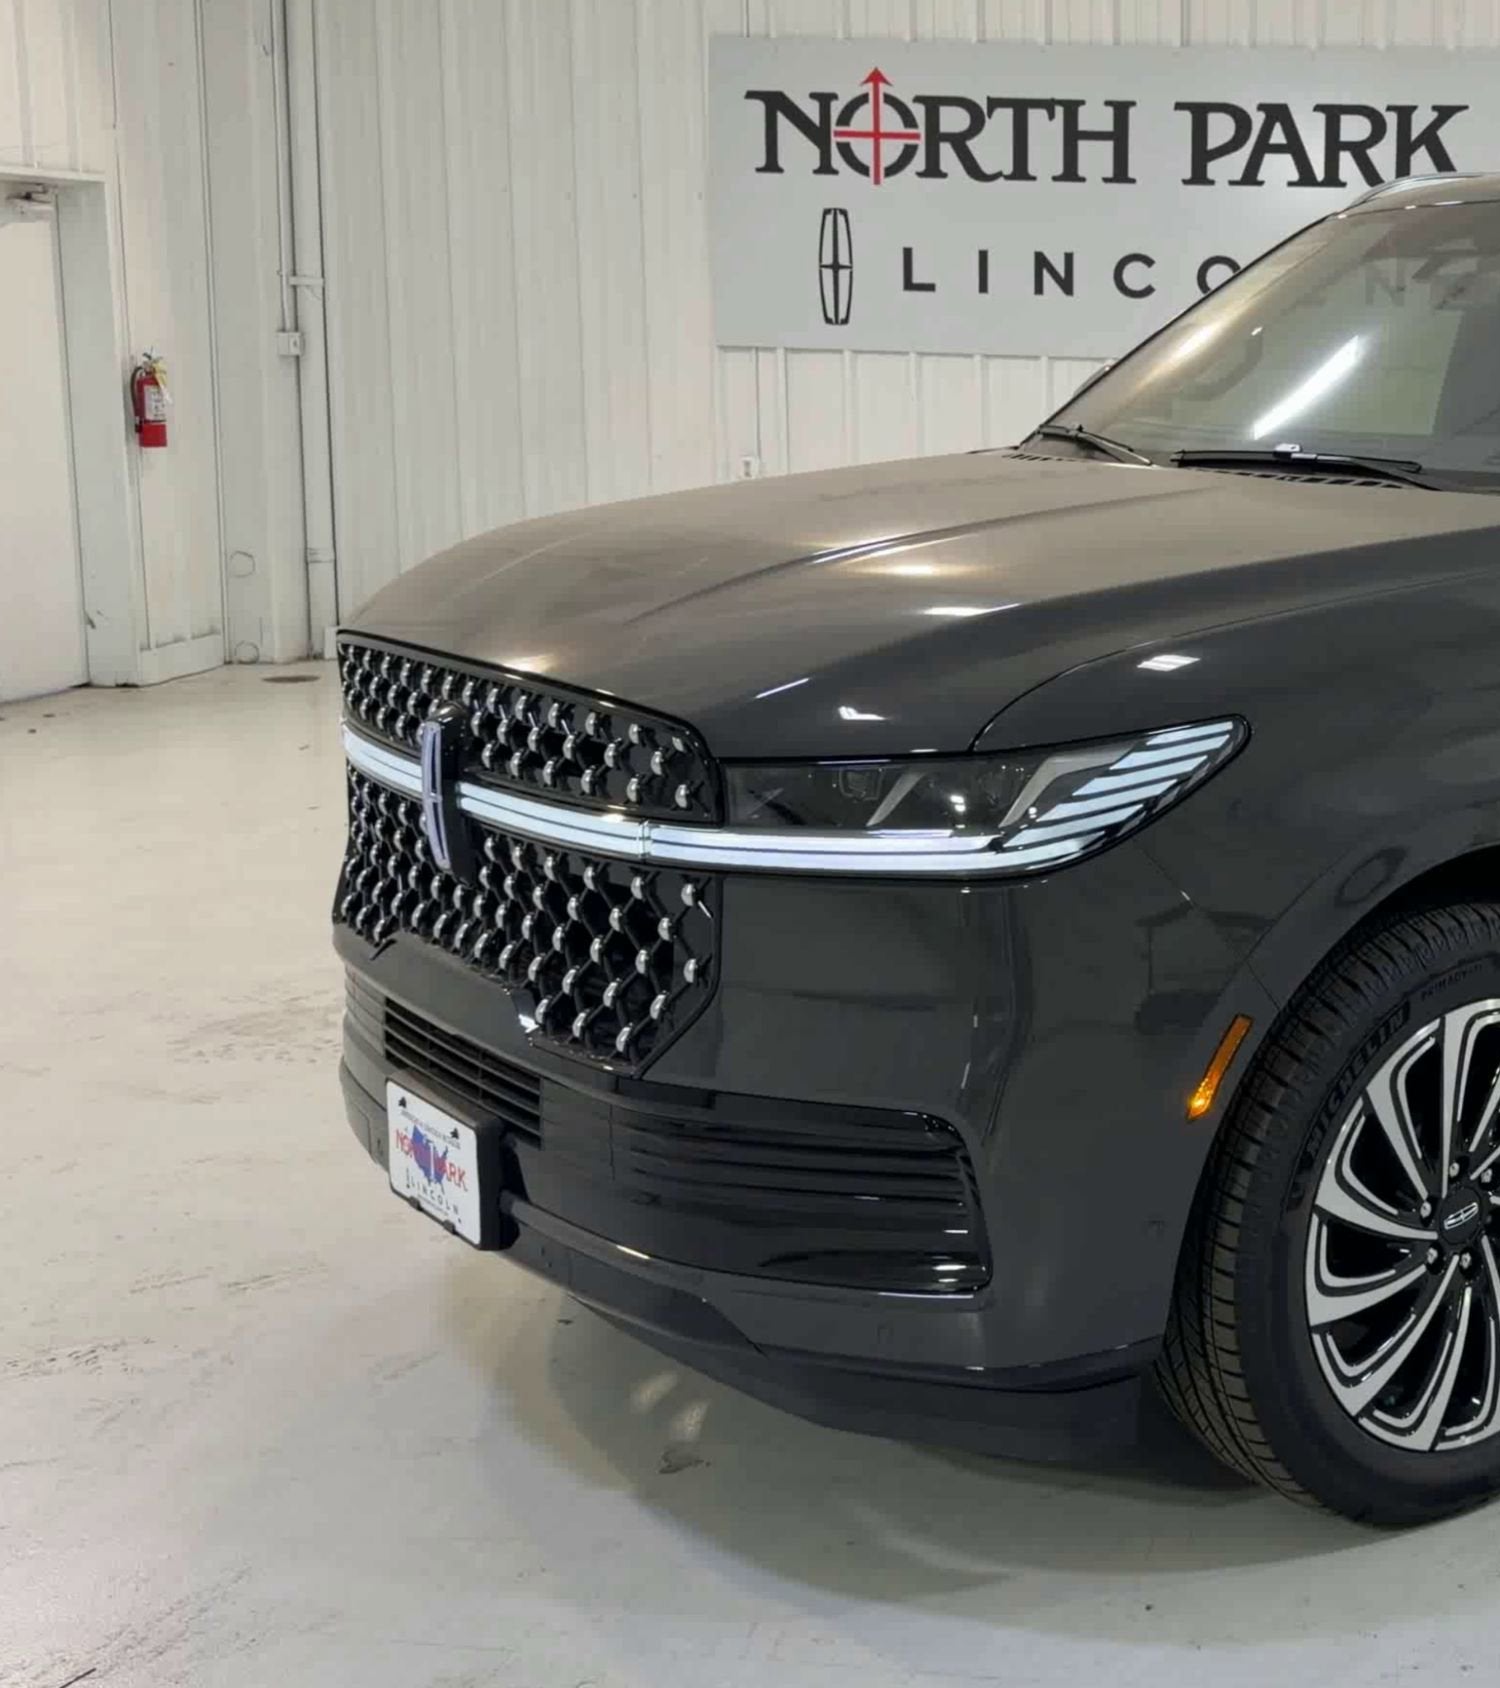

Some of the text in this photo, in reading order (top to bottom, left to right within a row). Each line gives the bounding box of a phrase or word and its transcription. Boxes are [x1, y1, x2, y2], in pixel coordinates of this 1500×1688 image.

[744, 89, 1470, 188] NORTH PARK
[1304, 1006, 1408, 1158] MICHELIN
[410, 1174, 459, 1216] LINCOLN
